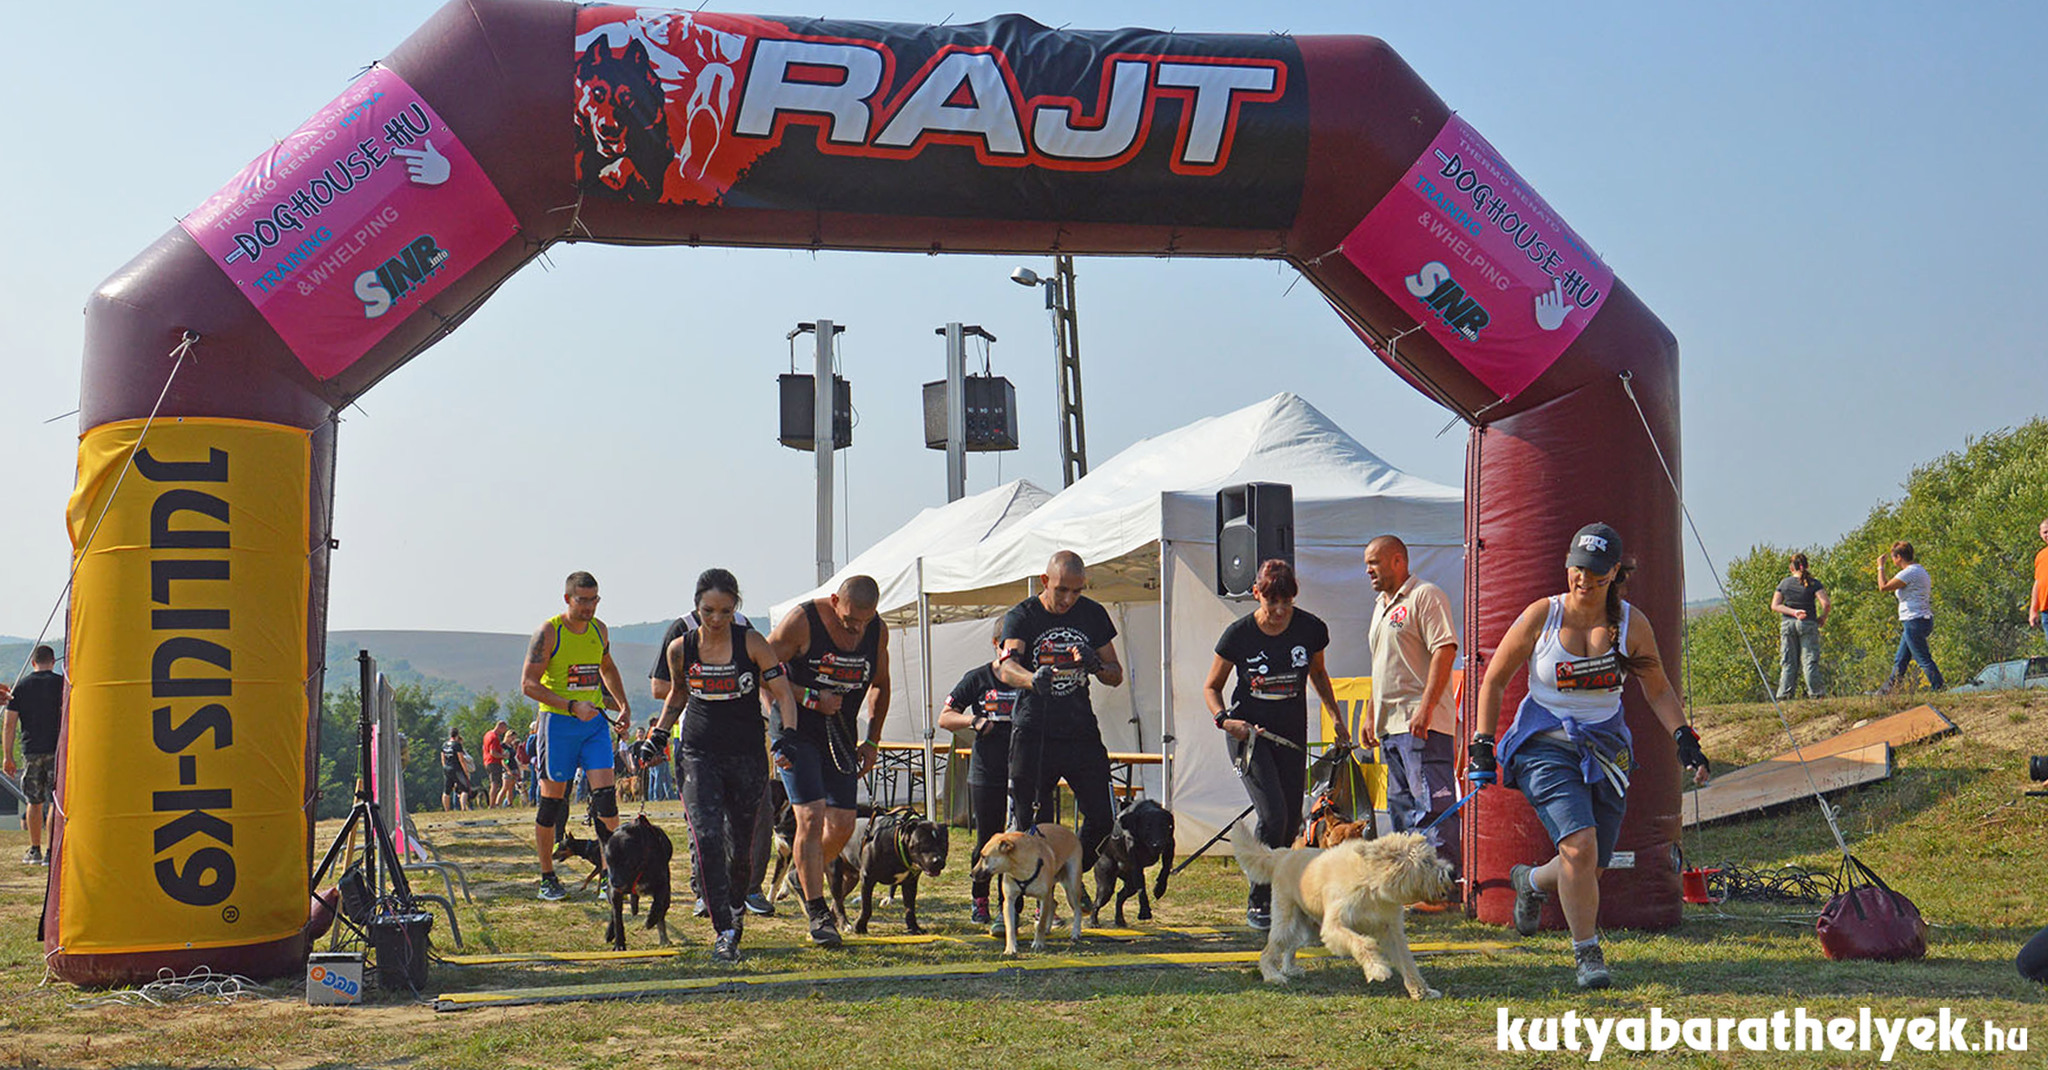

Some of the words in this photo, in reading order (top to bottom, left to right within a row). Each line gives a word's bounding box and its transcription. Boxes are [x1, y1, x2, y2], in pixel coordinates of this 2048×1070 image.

[736, 38, 1276, 163] RAJT
[213, 178, 279, 233] THERMO
[277, 128, 339, 180] RENATO
[338, 89, 386, 129] INFRA
[1458, 137, 1511, 187] THERMO
[1414, 173, 1483, 237] TRAINING
[251, 225, 334, 298] TRAINING
[705, 678, 736, 692] 940
[1579, 672, 1617, 688] 740
